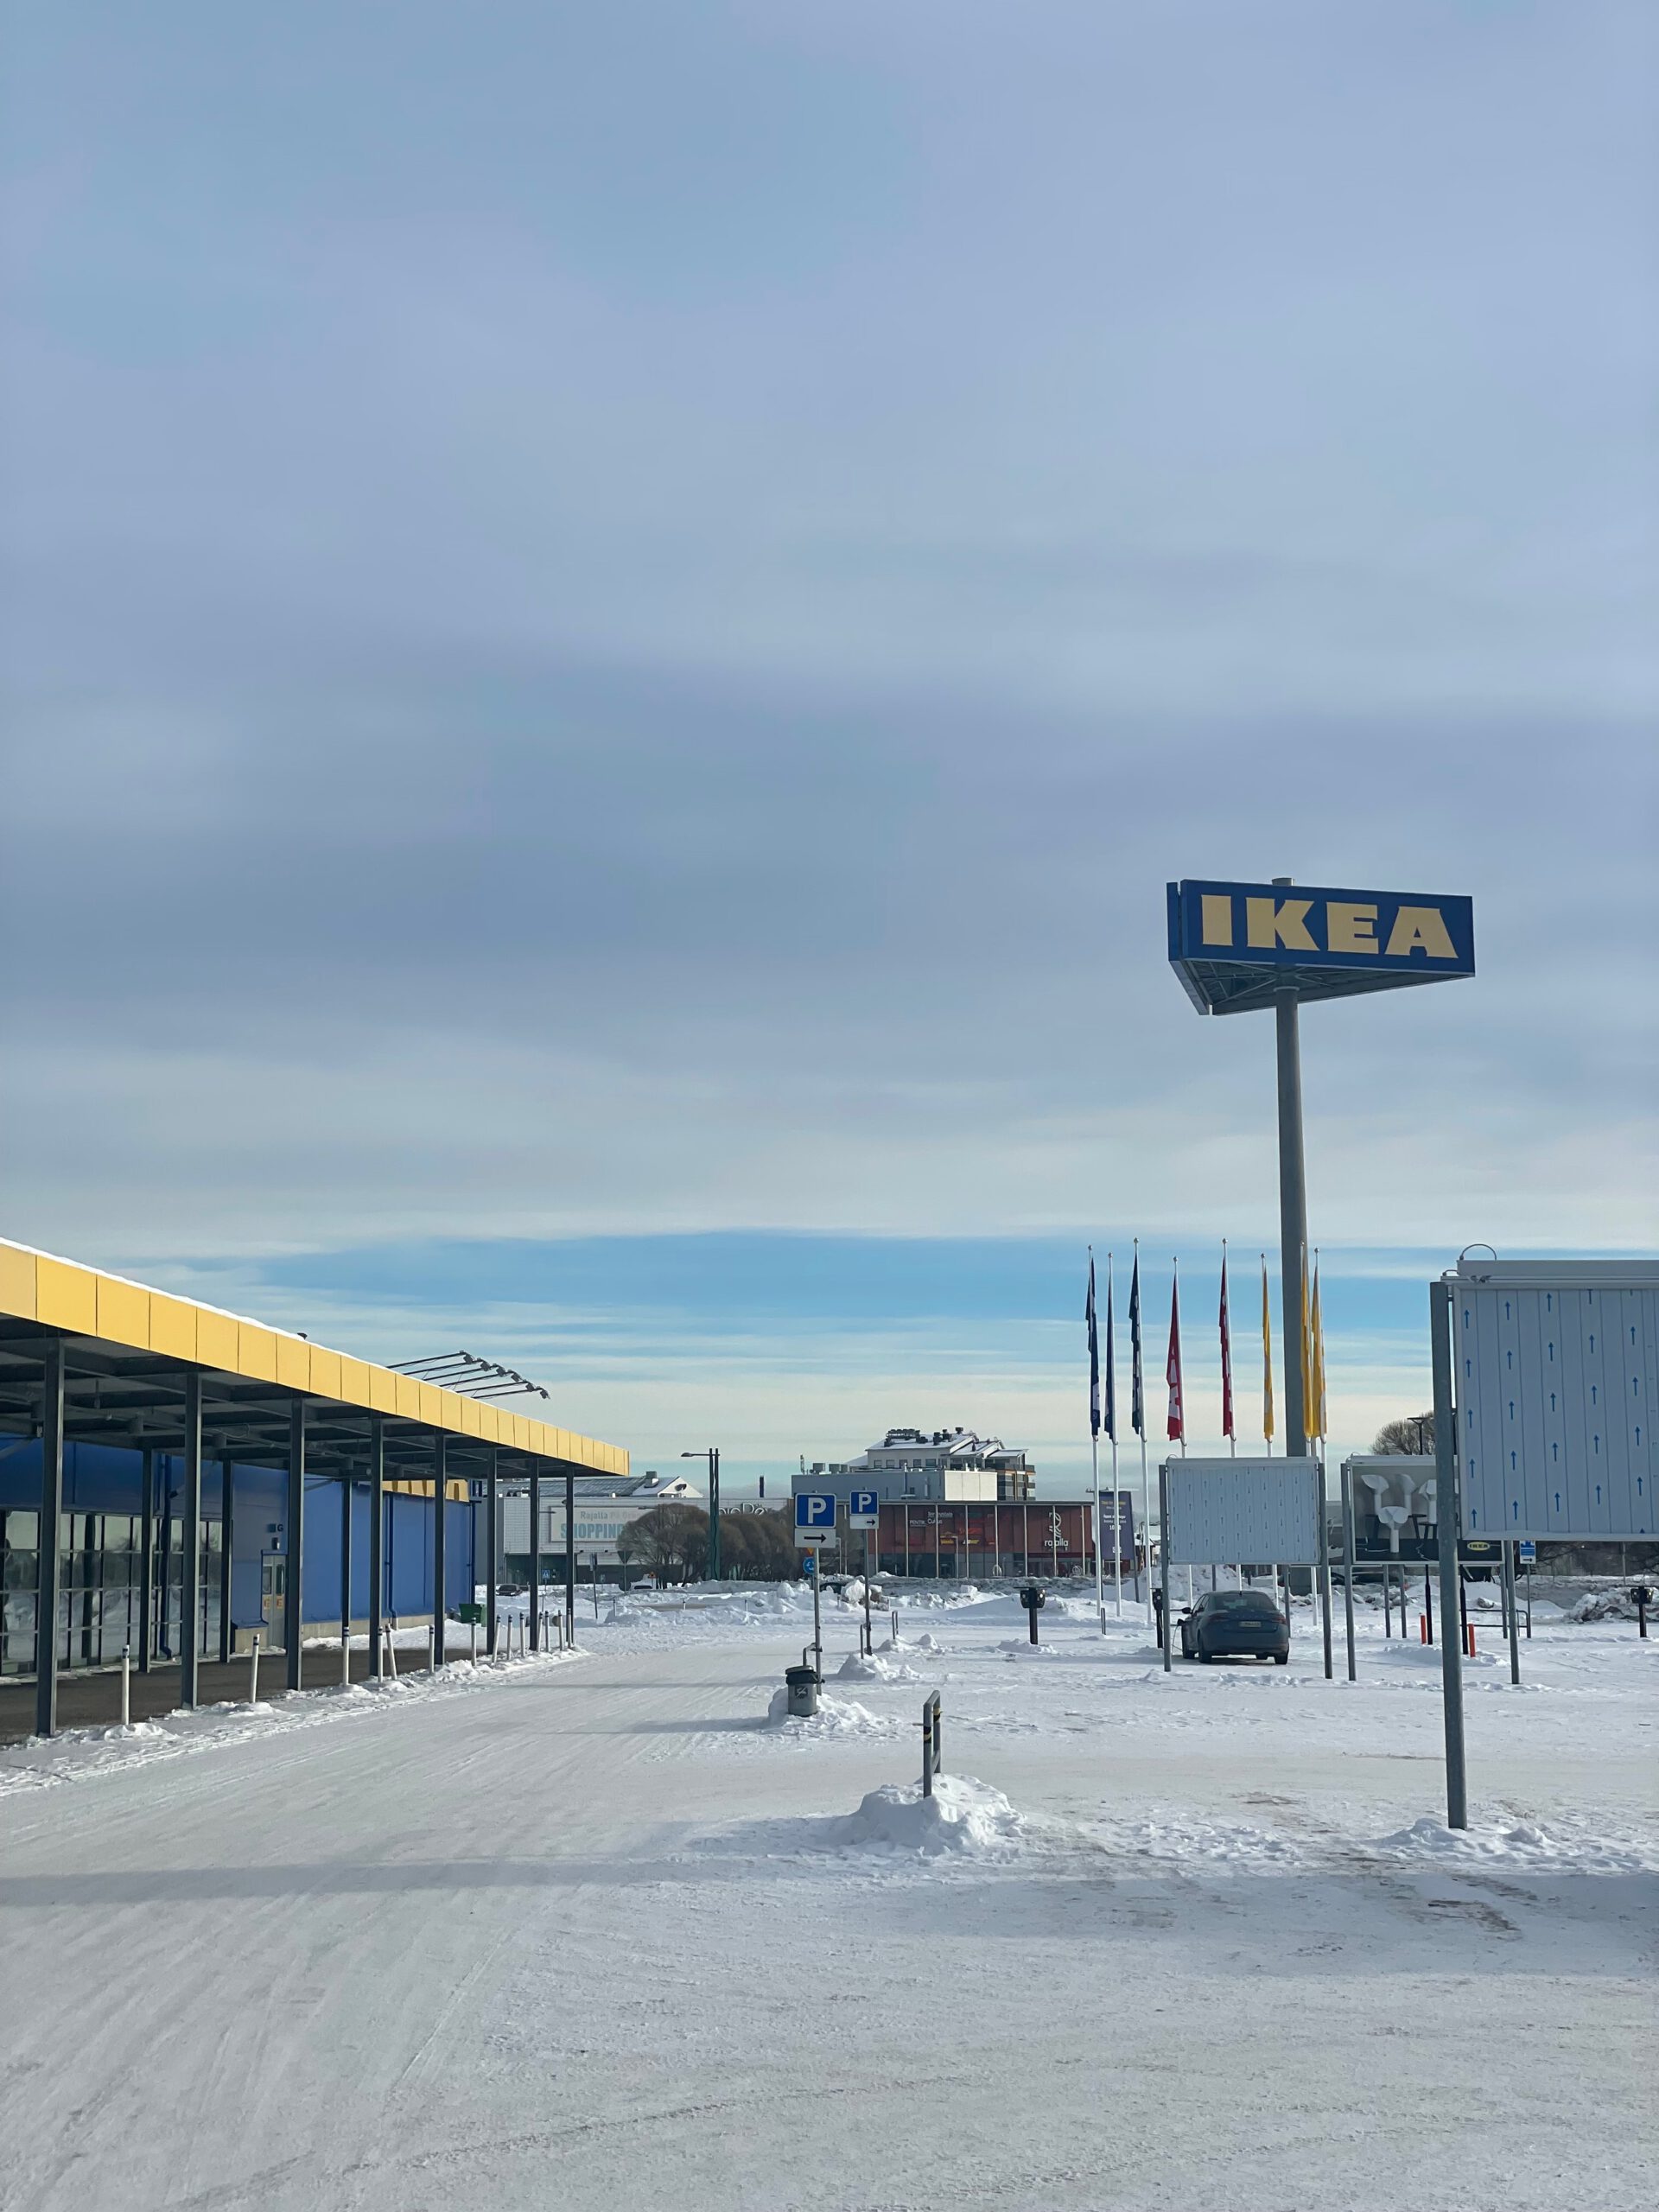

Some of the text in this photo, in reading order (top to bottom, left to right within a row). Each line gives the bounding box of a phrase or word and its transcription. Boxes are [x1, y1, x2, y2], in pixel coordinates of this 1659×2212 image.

[1201, 894, 1459, 959] IKEA
[808, 1497, 827, 1524] P
[858, 1493, 872, 1512] P
